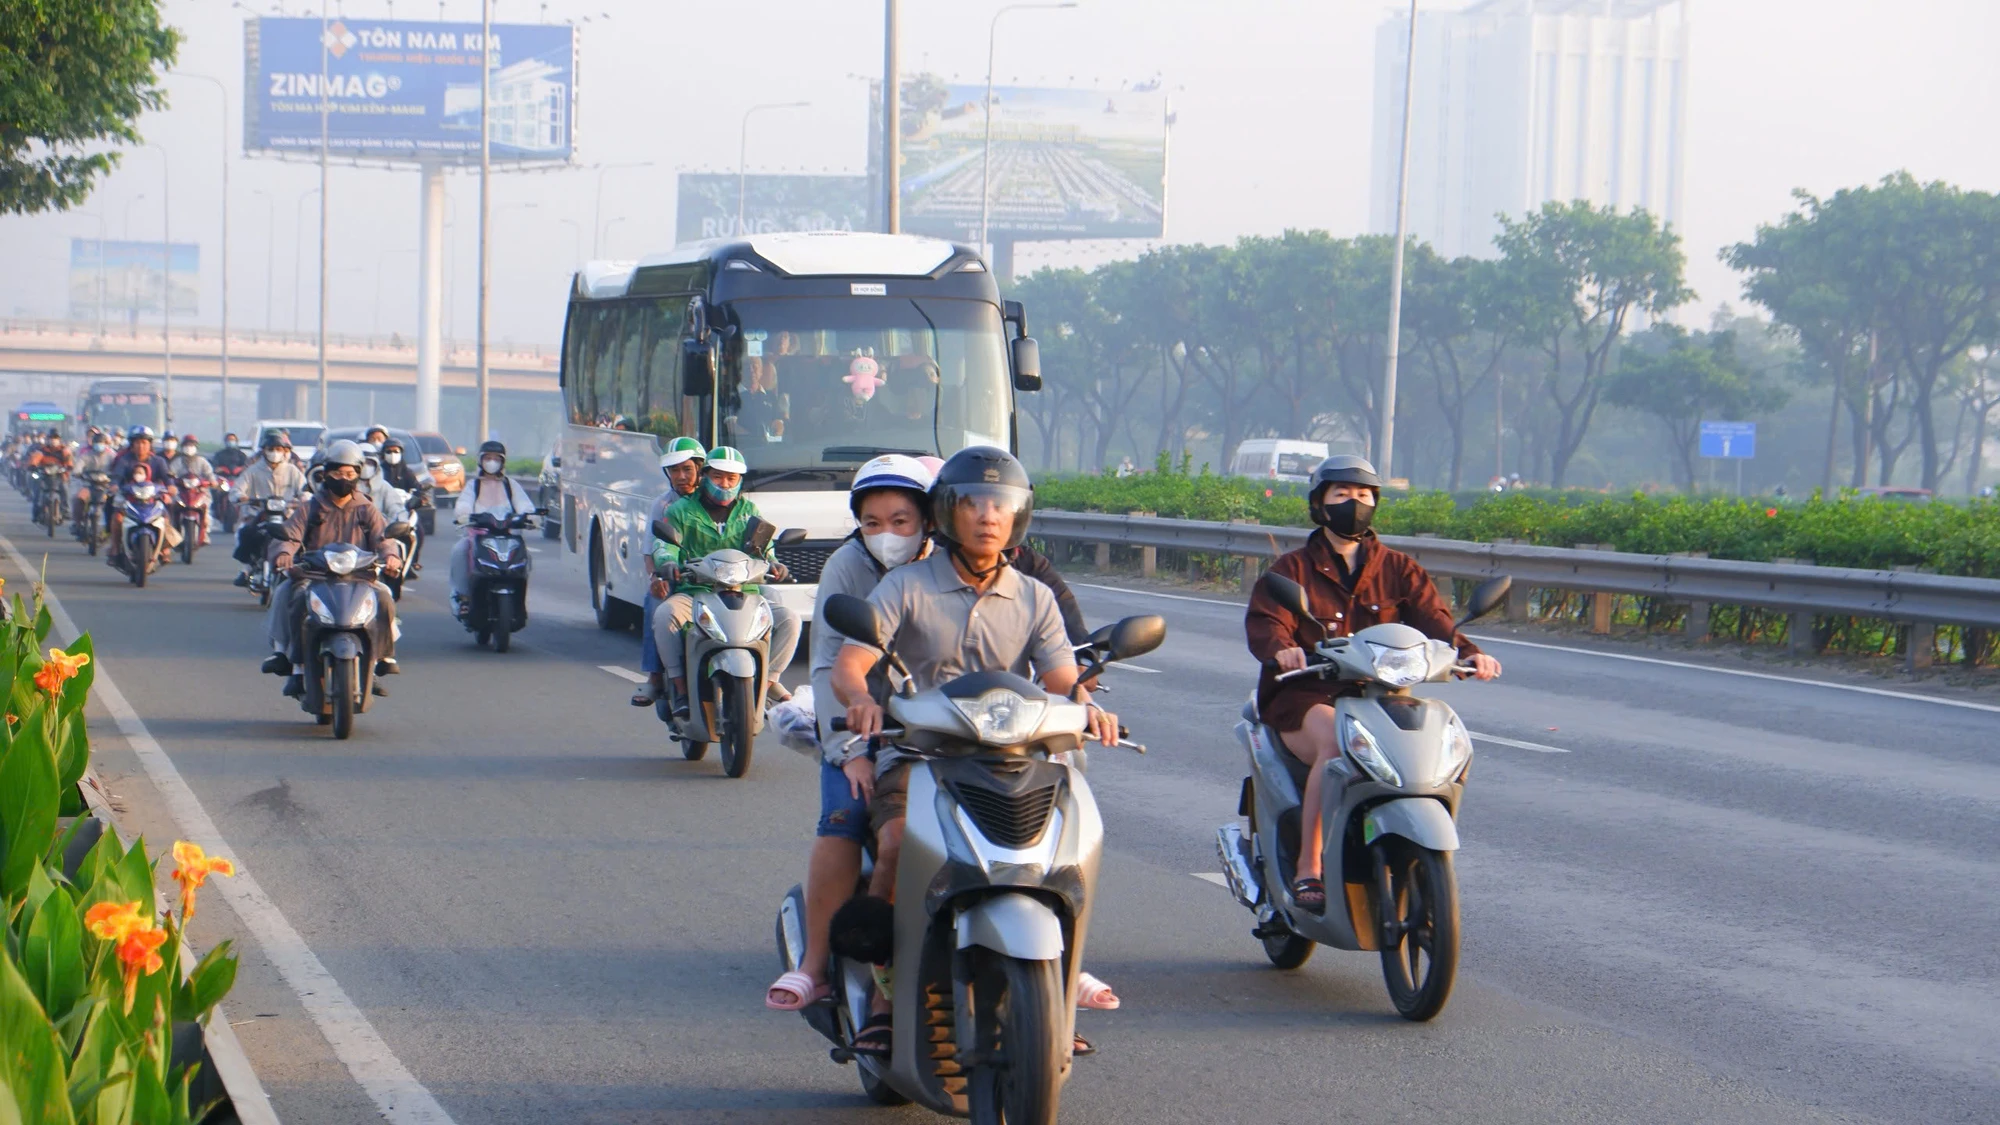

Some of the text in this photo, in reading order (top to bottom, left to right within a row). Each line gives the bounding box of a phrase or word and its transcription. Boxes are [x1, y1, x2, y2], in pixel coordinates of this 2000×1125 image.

[358, 27, 501, 51] TÔN NAM KIM
